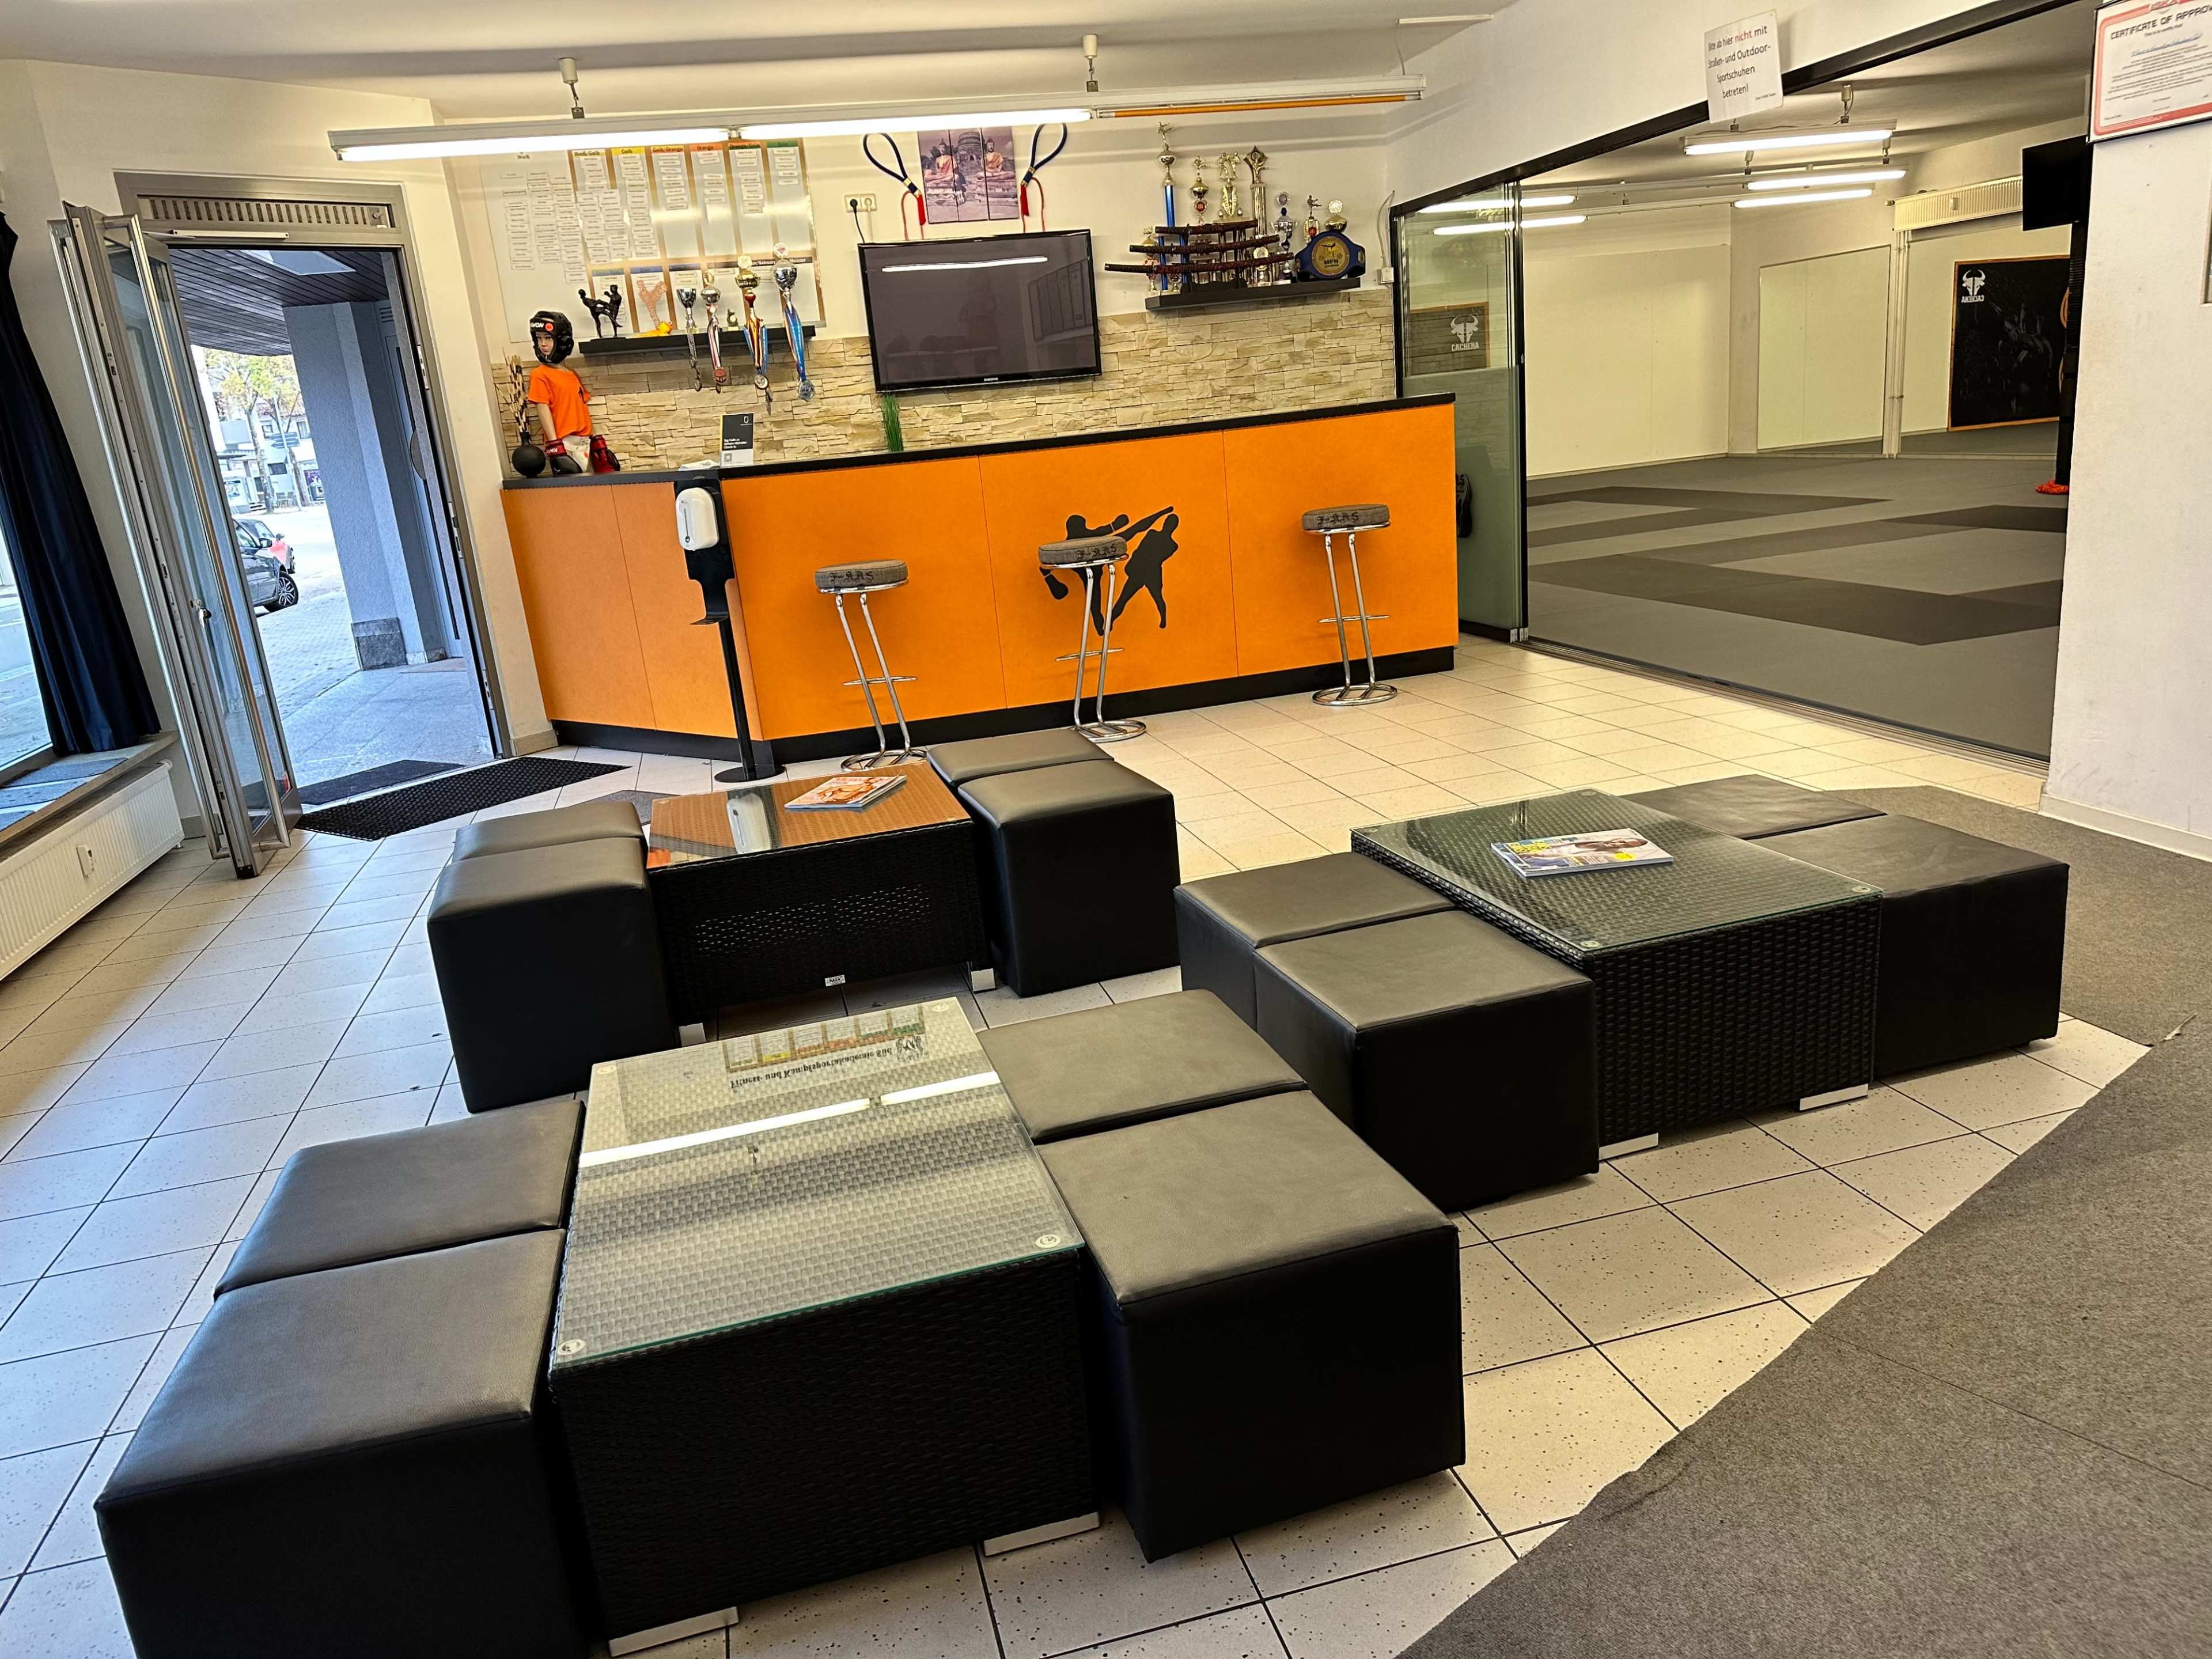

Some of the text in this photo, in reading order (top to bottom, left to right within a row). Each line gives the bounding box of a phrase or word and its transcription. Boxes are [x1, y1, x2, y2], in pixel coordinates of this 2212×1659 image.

[2110, 19, 2158, 40] CERTIFICATE
[2160, 14, 2173, 25] OF
[1717, 39, 1722, 49] ab
[1722, 37, 1733, 46] hier
[1734, 30, 1752, 43] nicht
[1754, 25, 1768, 37] mit
[1725, 52, 1736, 63] und
[1737, 44, 1771, 60] Outdoor-
[1717, 66, 1755, 83] Sportschuhen
[1722, 84, 1749, 99] betreten!
